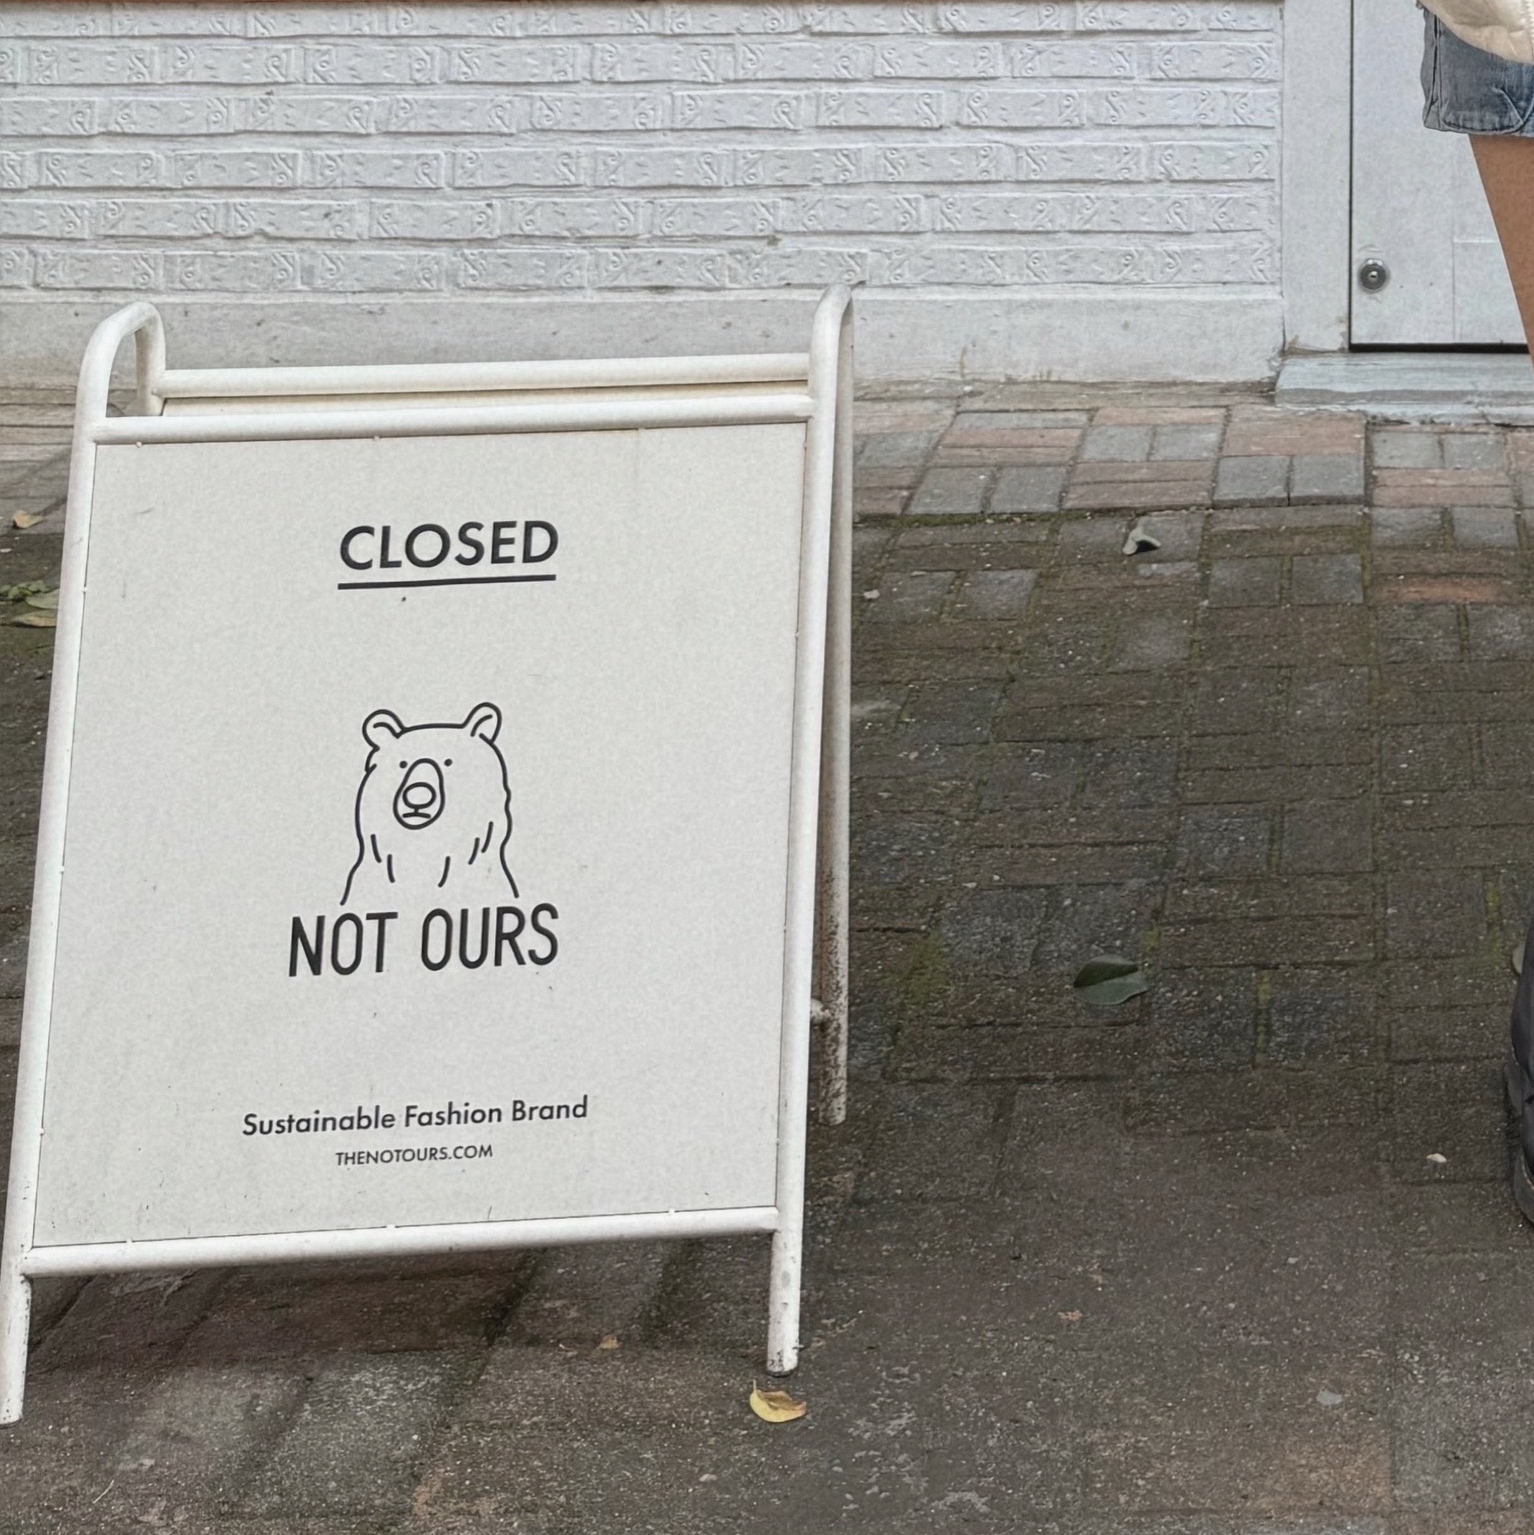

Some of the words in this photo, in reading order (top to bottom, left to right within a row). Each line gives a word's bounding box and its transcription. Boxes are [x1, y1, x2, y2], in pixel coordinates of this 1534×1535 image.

[339, 520, 559, 570] CLOSED
[288, 911, 399, 977] NOT
[421, 903, 559, 971] OURS
[242, 1105, 396, 1136] Sustainable
[404, 1101, 503, 1128] Fashion
[511, 1094, 588, 1122] Brand
[335, 1144, 494, 1167] THENOTOURS.COM
